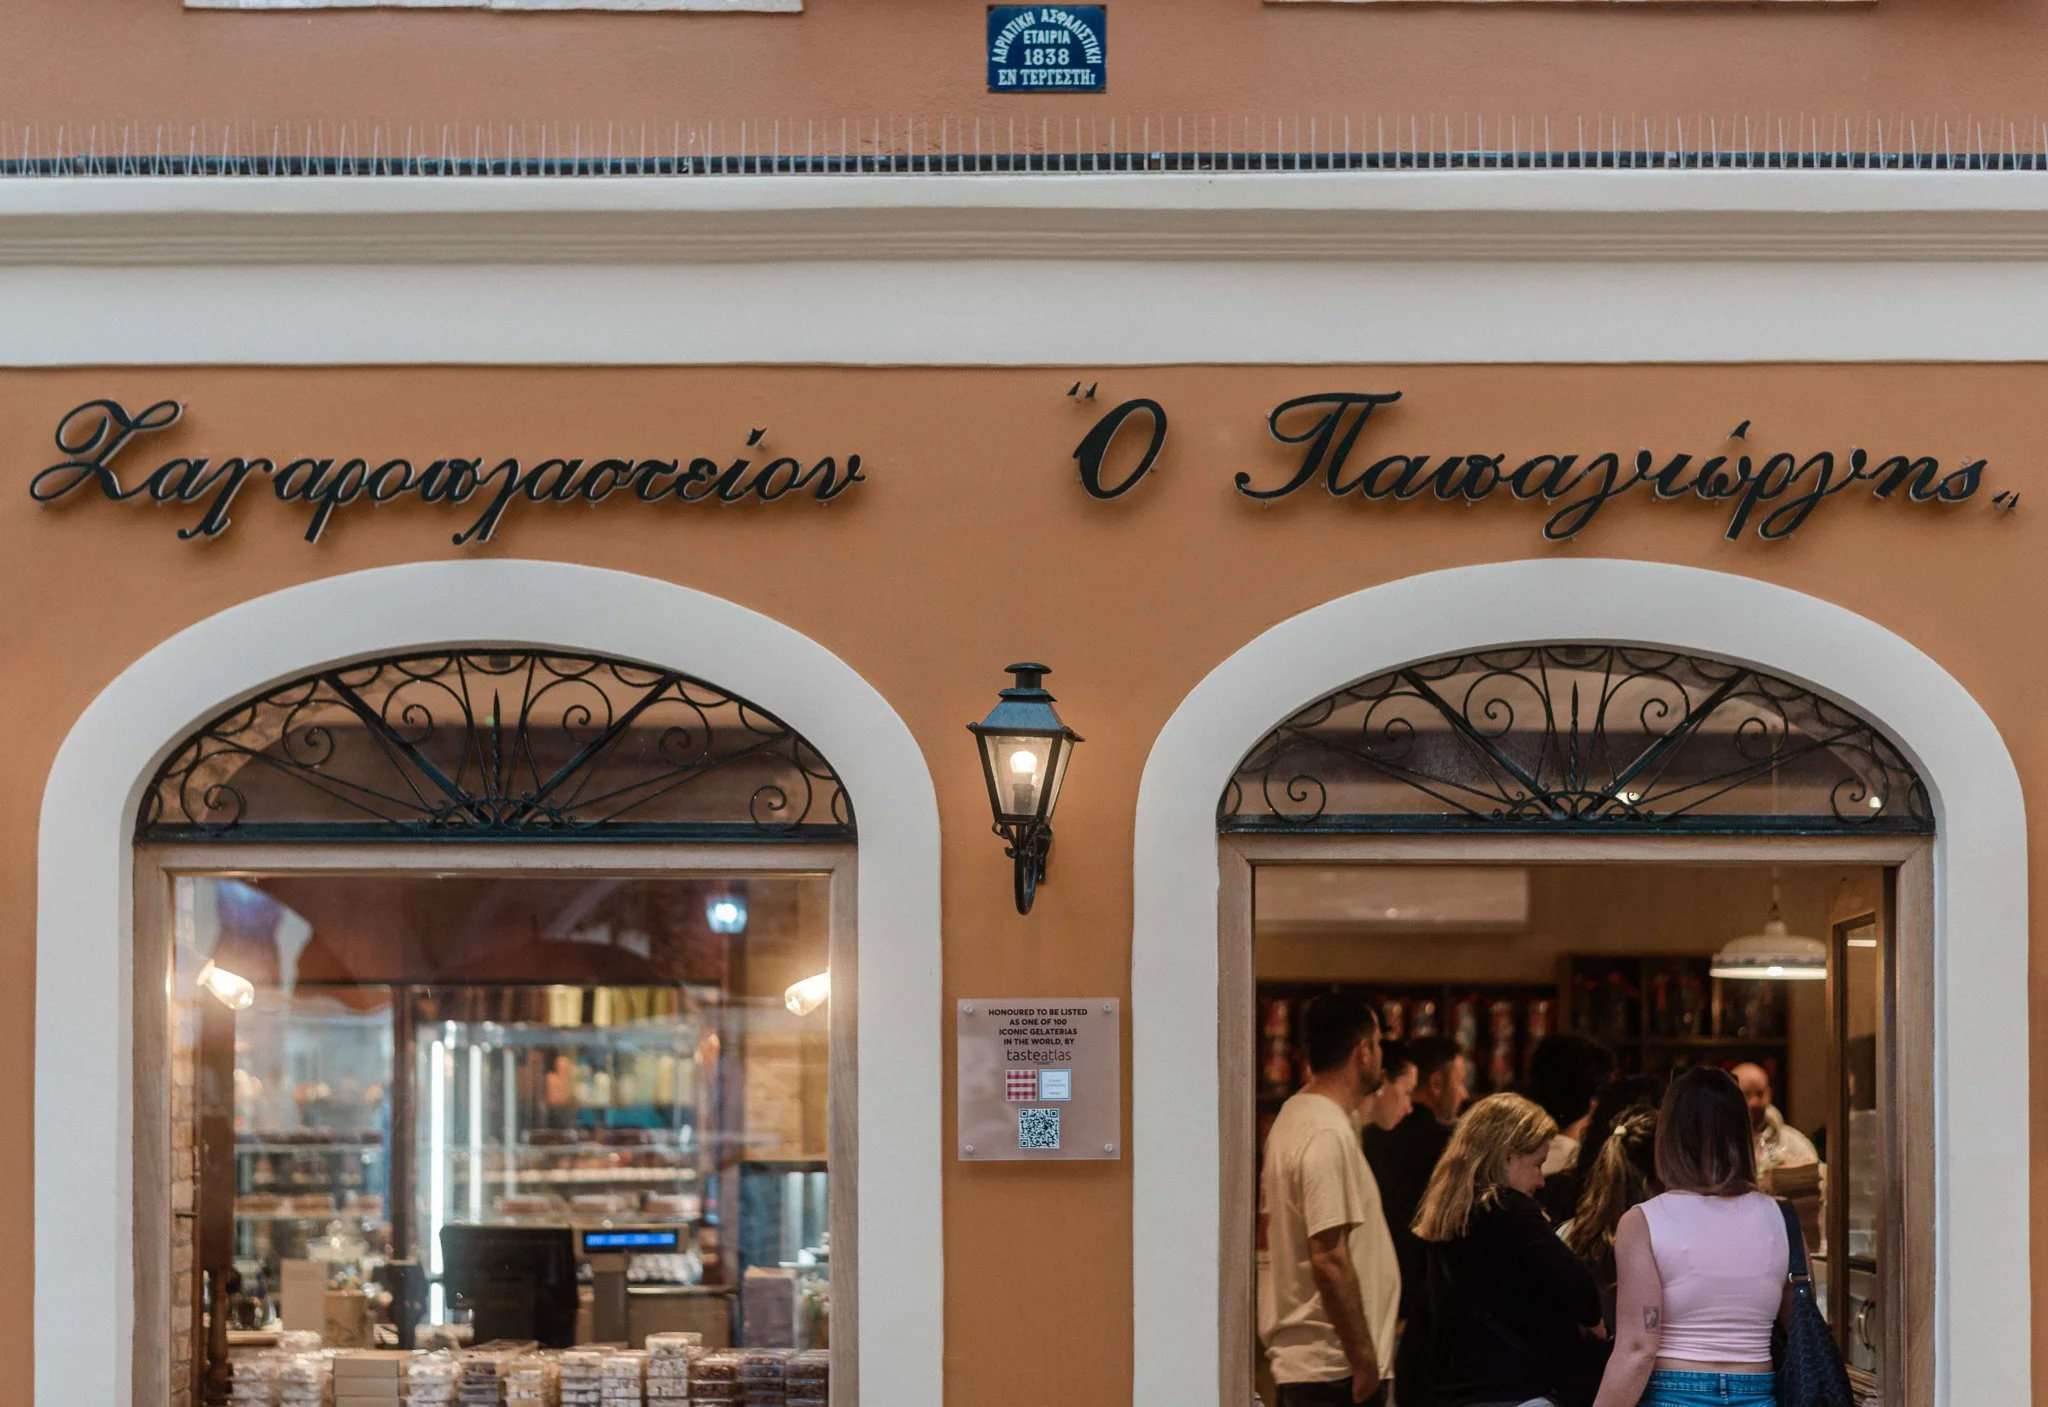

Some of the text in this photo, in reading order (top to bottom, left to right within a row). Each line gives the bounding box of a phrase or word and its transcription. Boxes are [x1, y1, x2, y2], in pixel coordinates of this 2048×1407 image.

[991, 8, 1102, 64] ΑΔΡΙΑΤΙΚΗ ΑΣΦΑΛΙΣΤΙΚΗ
[1023, 29, 1071, 45] ΕΤΑΙΡΙΑ
[1023, 48, 1070, 66] 1838
[997, 69, 1017, 86] ΕΝ
[29, 398, 867, 544] Ζαχαροπλαστείον
[988, 1008, 1088, 1016] HONOURED TO BE LISTED
[1009, 1018, 1068, 1026] AS ONE OF 100
[998, 1028, 1078, 1036] ICONIC GELATERIAS
[1003, 1038, 1075, 1047] IN THE WORLD, BY
[1006, 1049, 1072, 1062] tasteatlas
